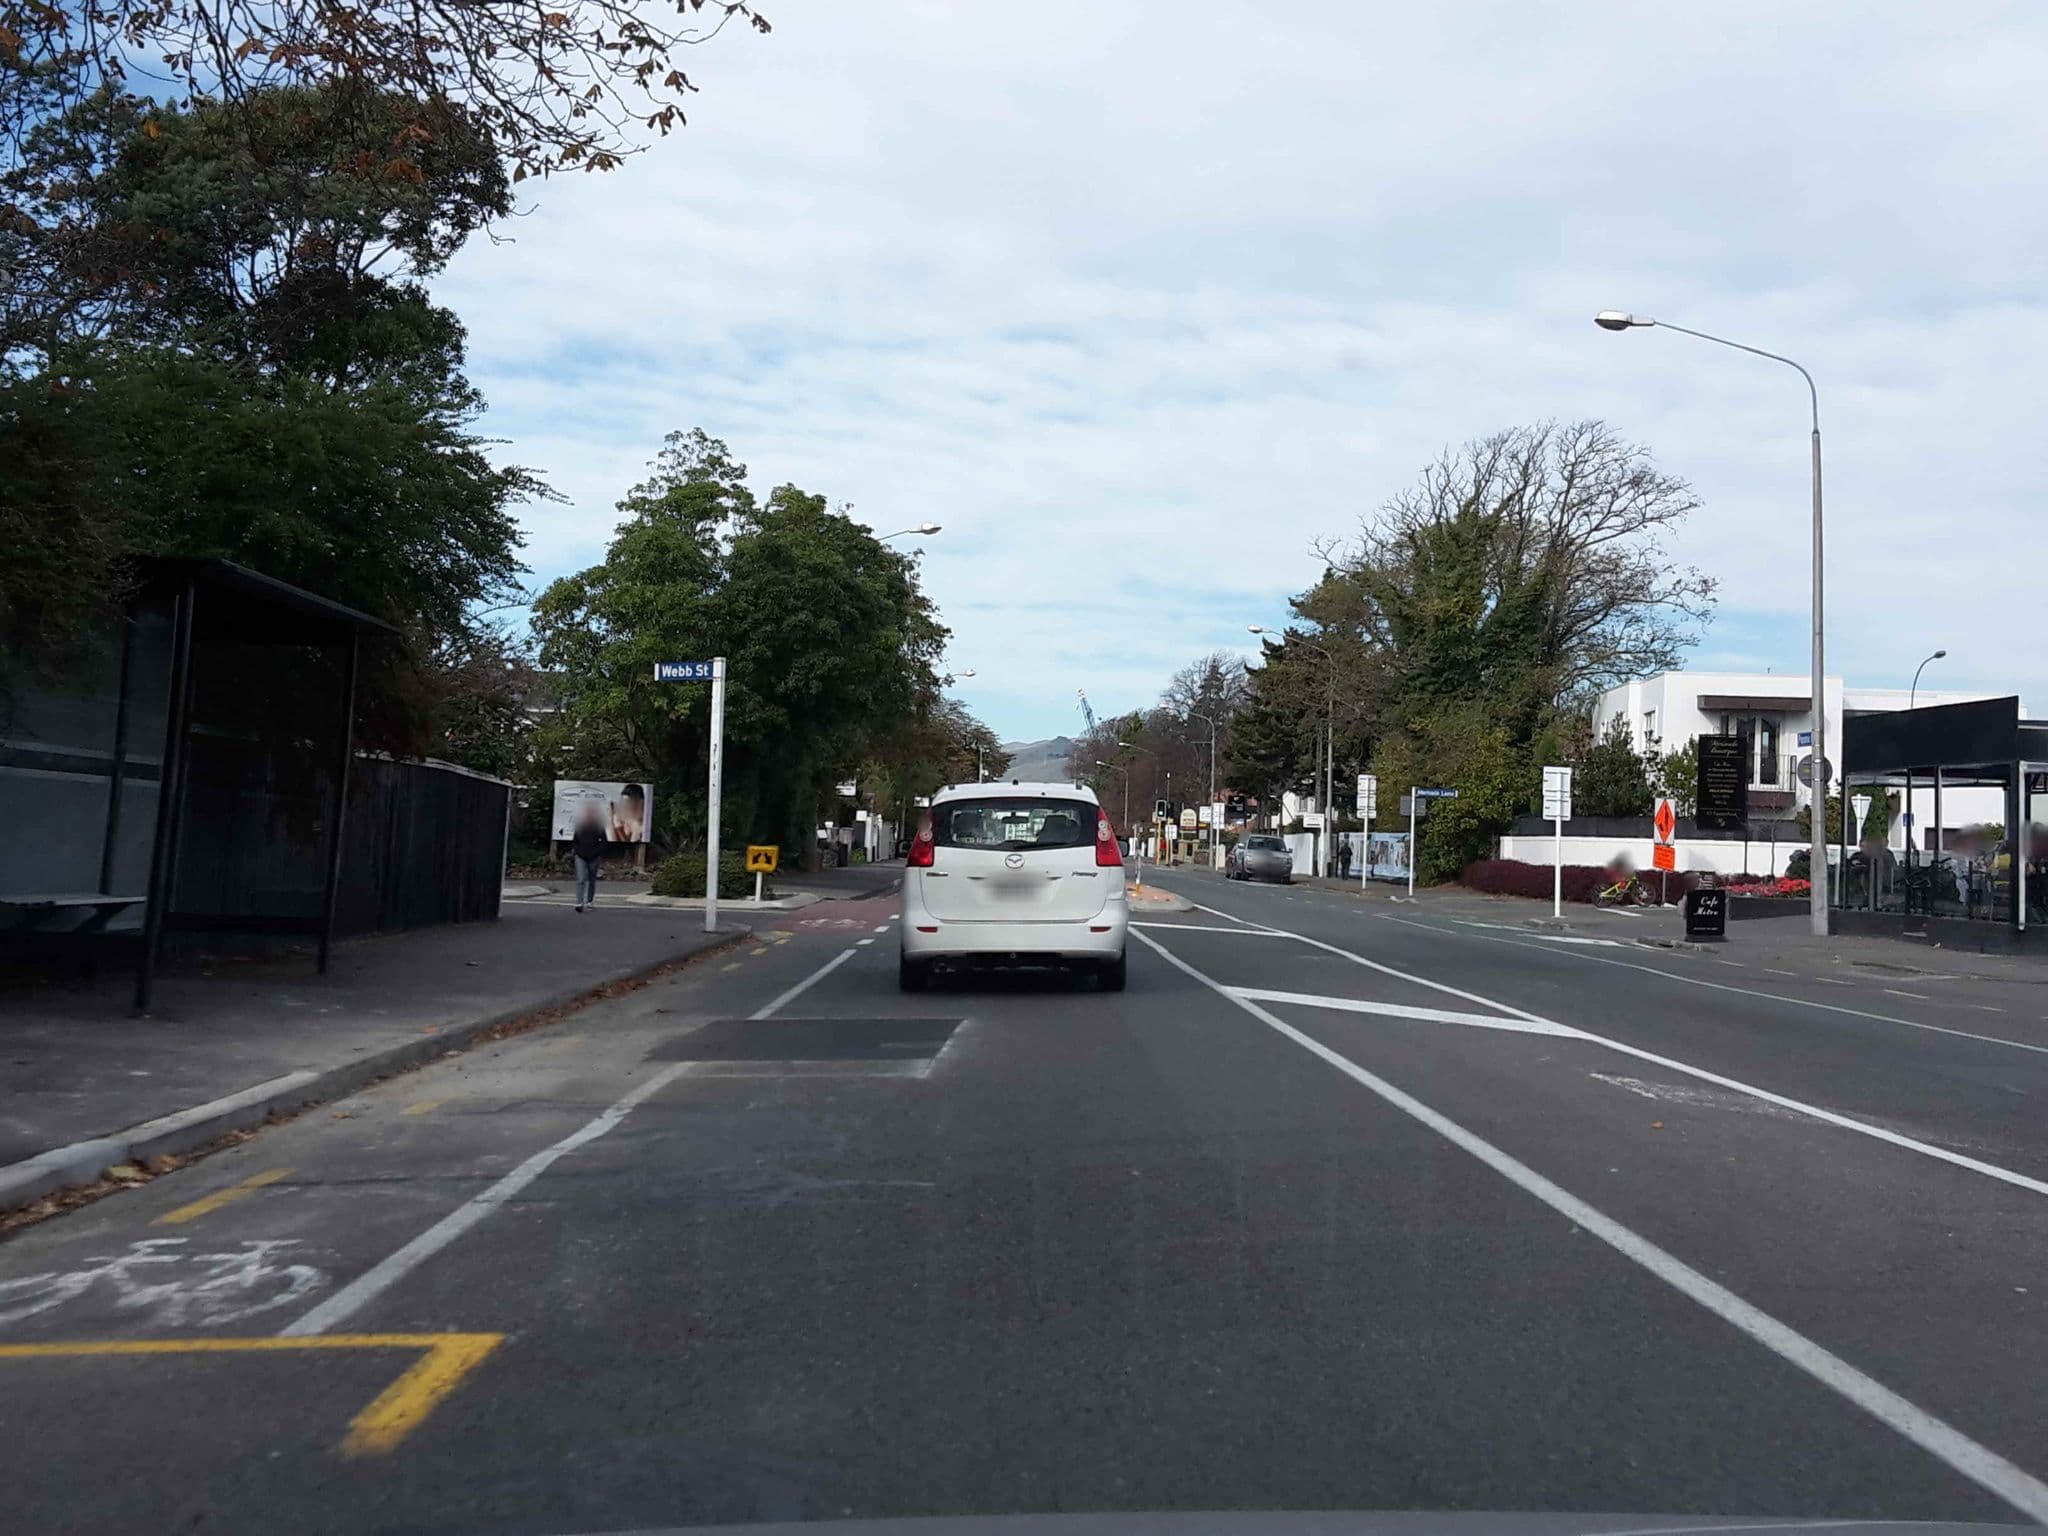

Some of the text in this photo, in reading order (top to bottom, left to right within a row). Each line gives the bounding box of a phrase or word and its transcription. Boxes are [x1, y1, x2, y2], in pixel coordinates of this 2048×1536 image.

[661, 664, 709, 678] Webb St
[1692, 906, 1719, 915] Metro
